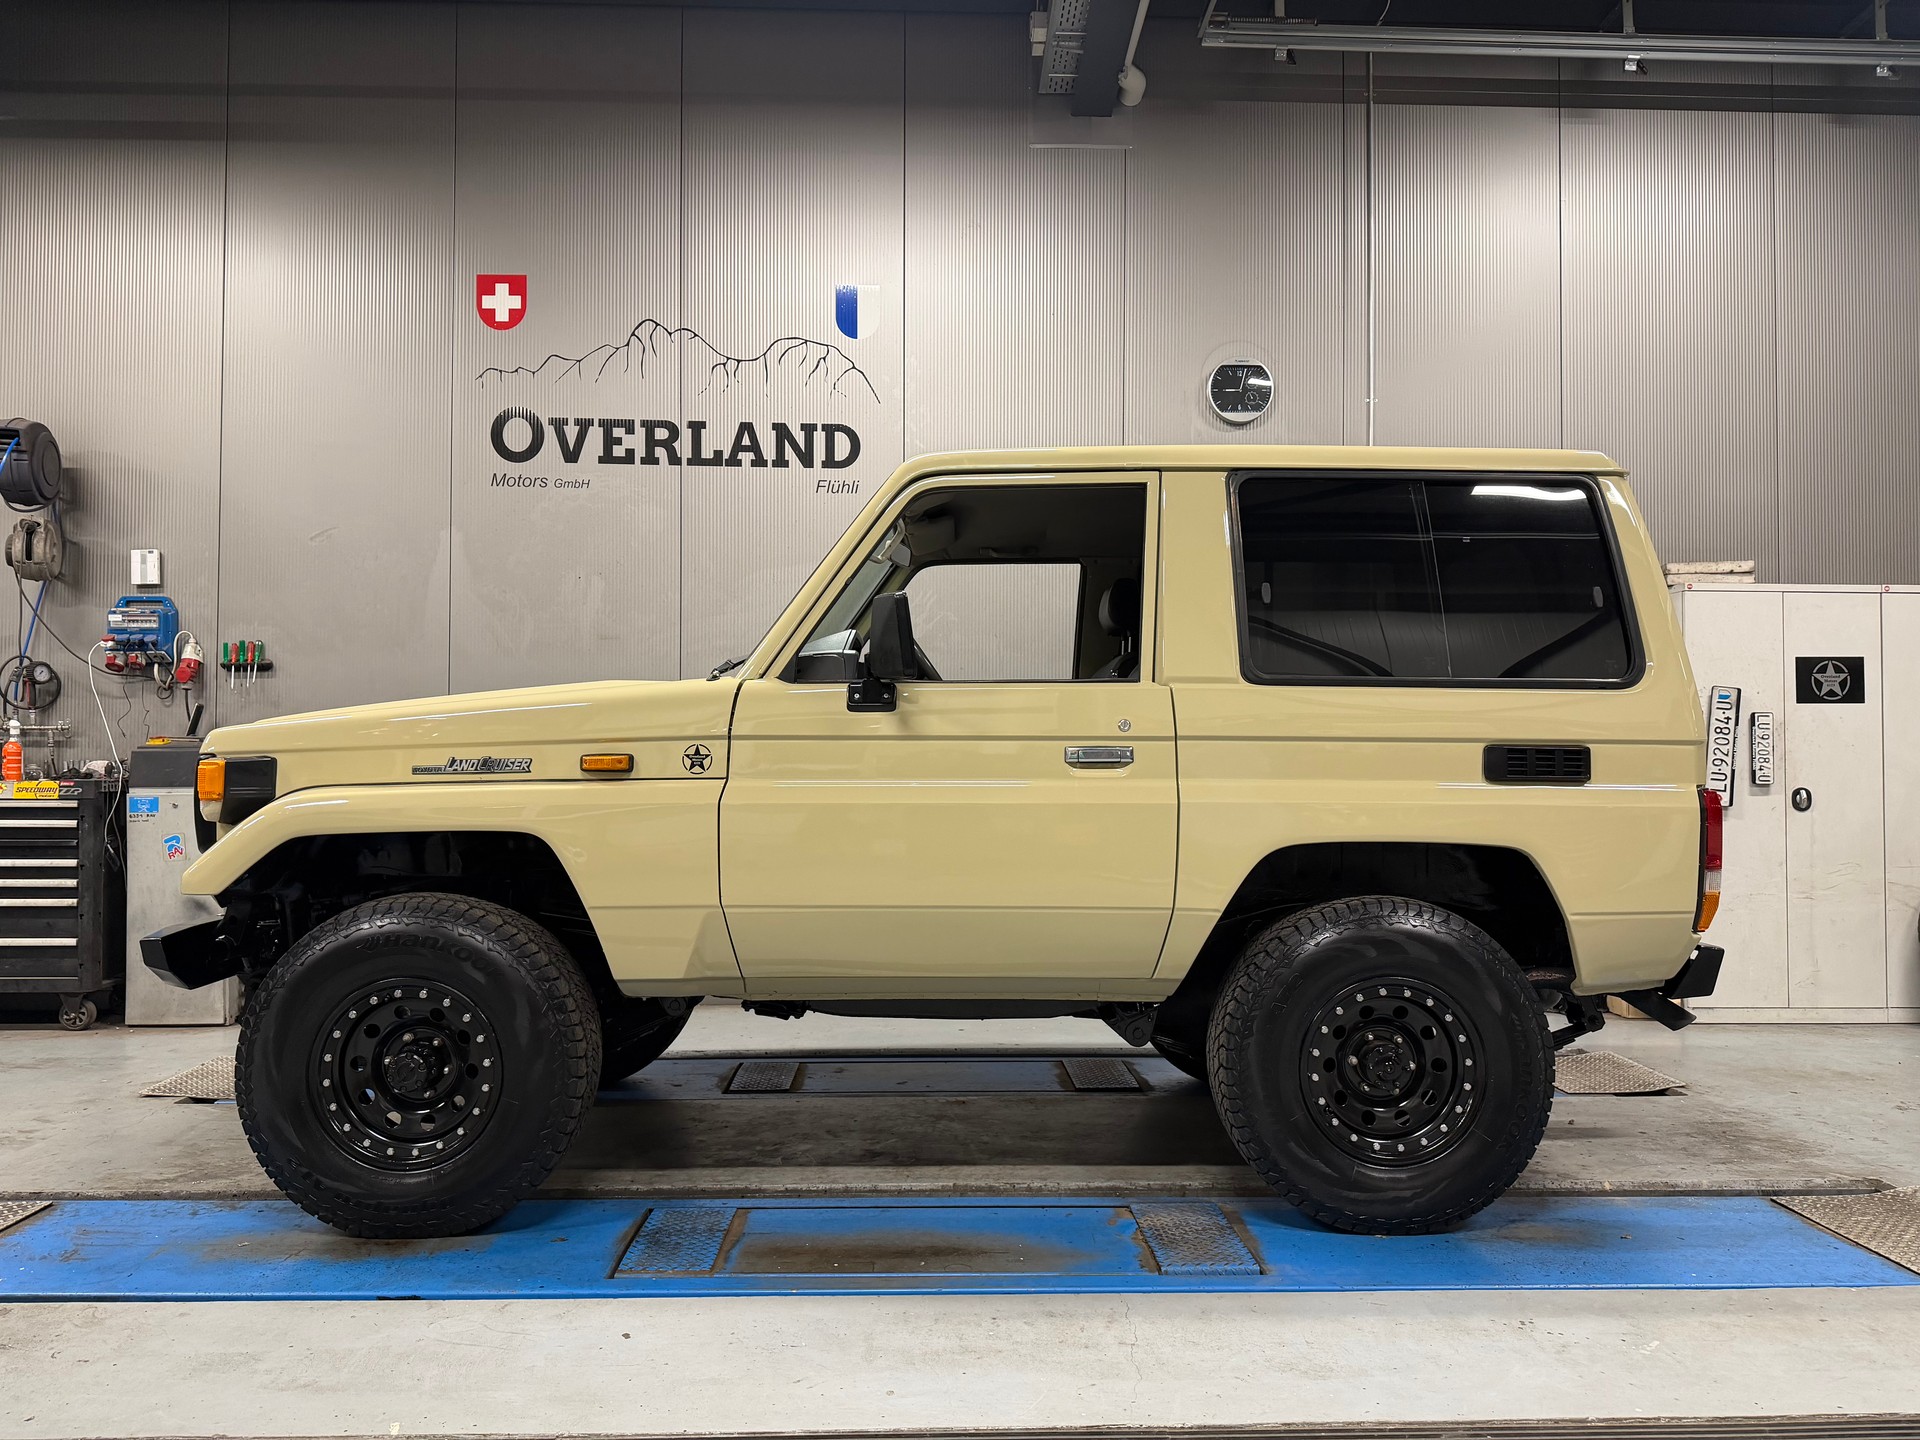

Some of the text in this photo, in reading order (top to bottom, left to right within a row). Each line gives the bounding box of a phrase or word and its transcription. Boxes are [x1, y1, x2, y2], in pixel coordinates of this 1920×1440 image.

[490, 406, 861, 469] OVERLAND
[490, 472, 591, 489] Motors GmbH
[815, 478, 861, 495] Flühli
